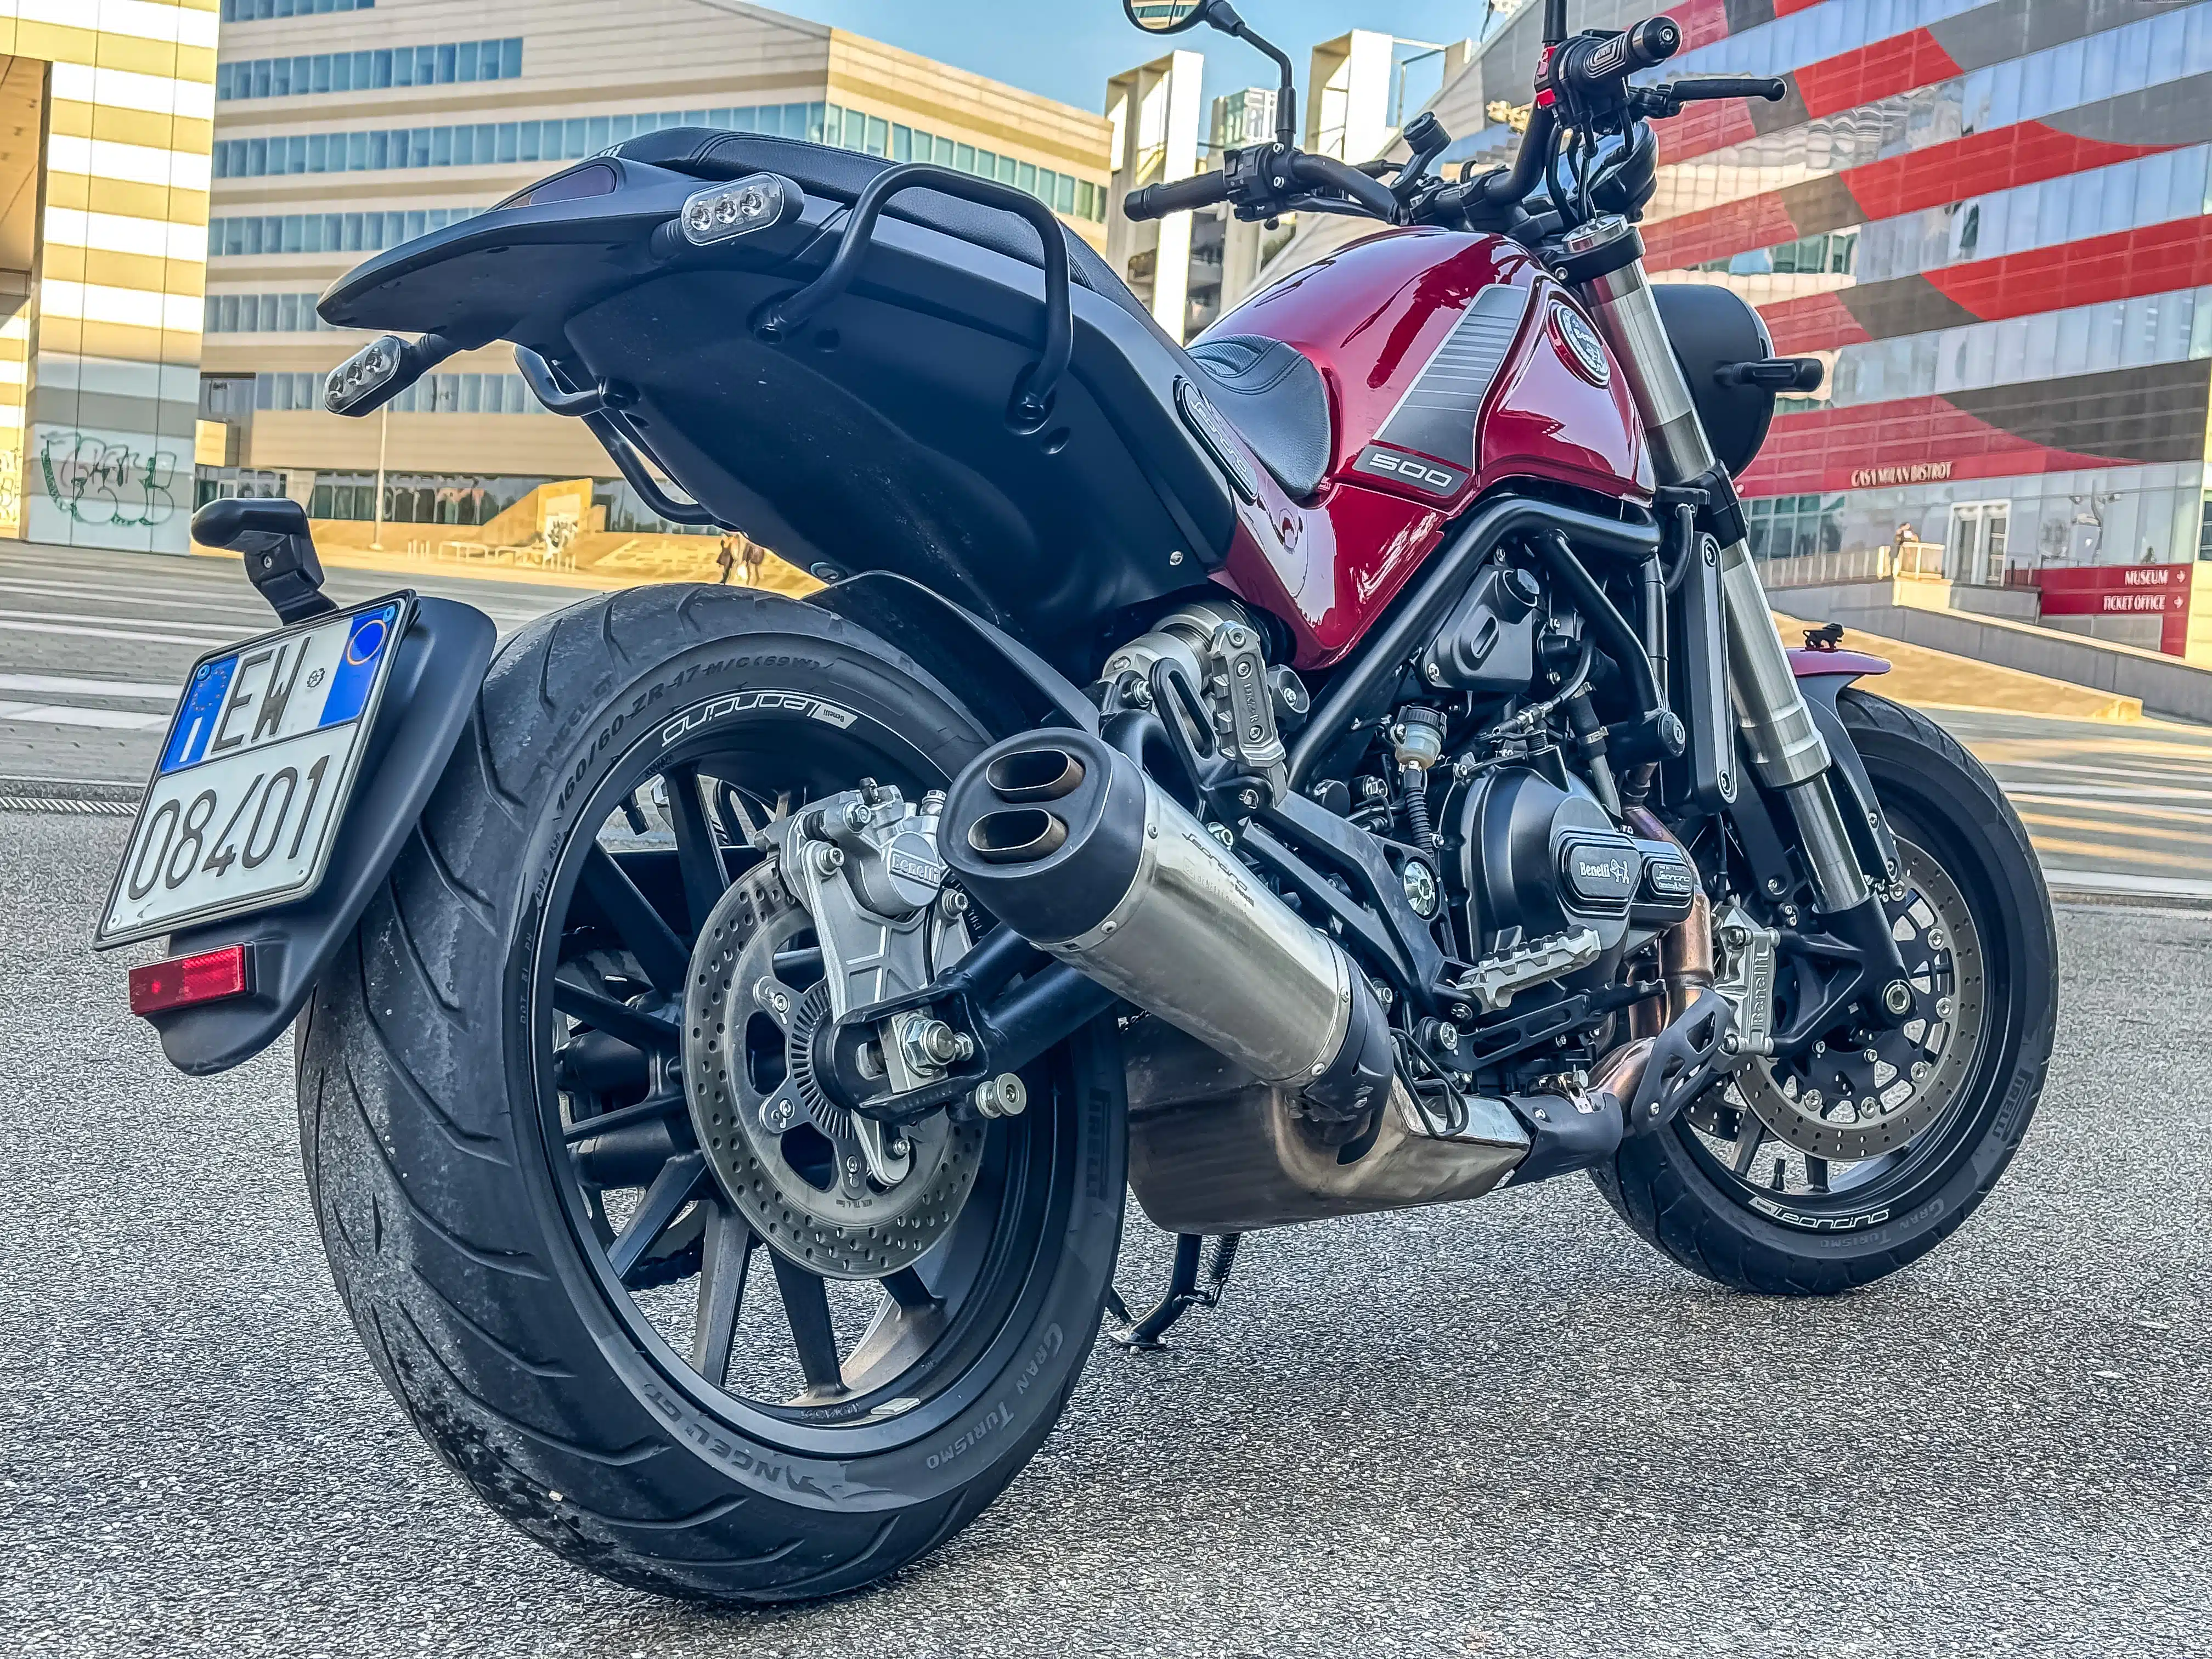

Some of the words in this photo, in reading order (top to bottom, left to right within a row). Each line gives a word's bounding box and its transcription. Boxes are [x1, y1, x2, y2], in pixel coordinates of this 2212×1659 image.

[1369, 453, 1452, 488] 500
[2125, 569, 2169, 585] MUSEUM
[2103, 595, 2134, 611] TICKET
[2134, 595, 2166, 611] OFFICE
[211, 636, 311, 754] EW
[823, 709, 845, 724] Benelli
[128, 754, 330, 900] 08401
[892, 854, 941, 885] Benelli
[1579, 861, 1611, 878] Benelli
[1751, 957, 1769, 1028] Benelli
[1899, 1198, 1945, 1231] GRAN
[1819, 1229, 1892, 1248] TURISMO
[1016, 1323, 1064, 1395] GRAN
[926, 1401, 1014, 1470] TURISMO
